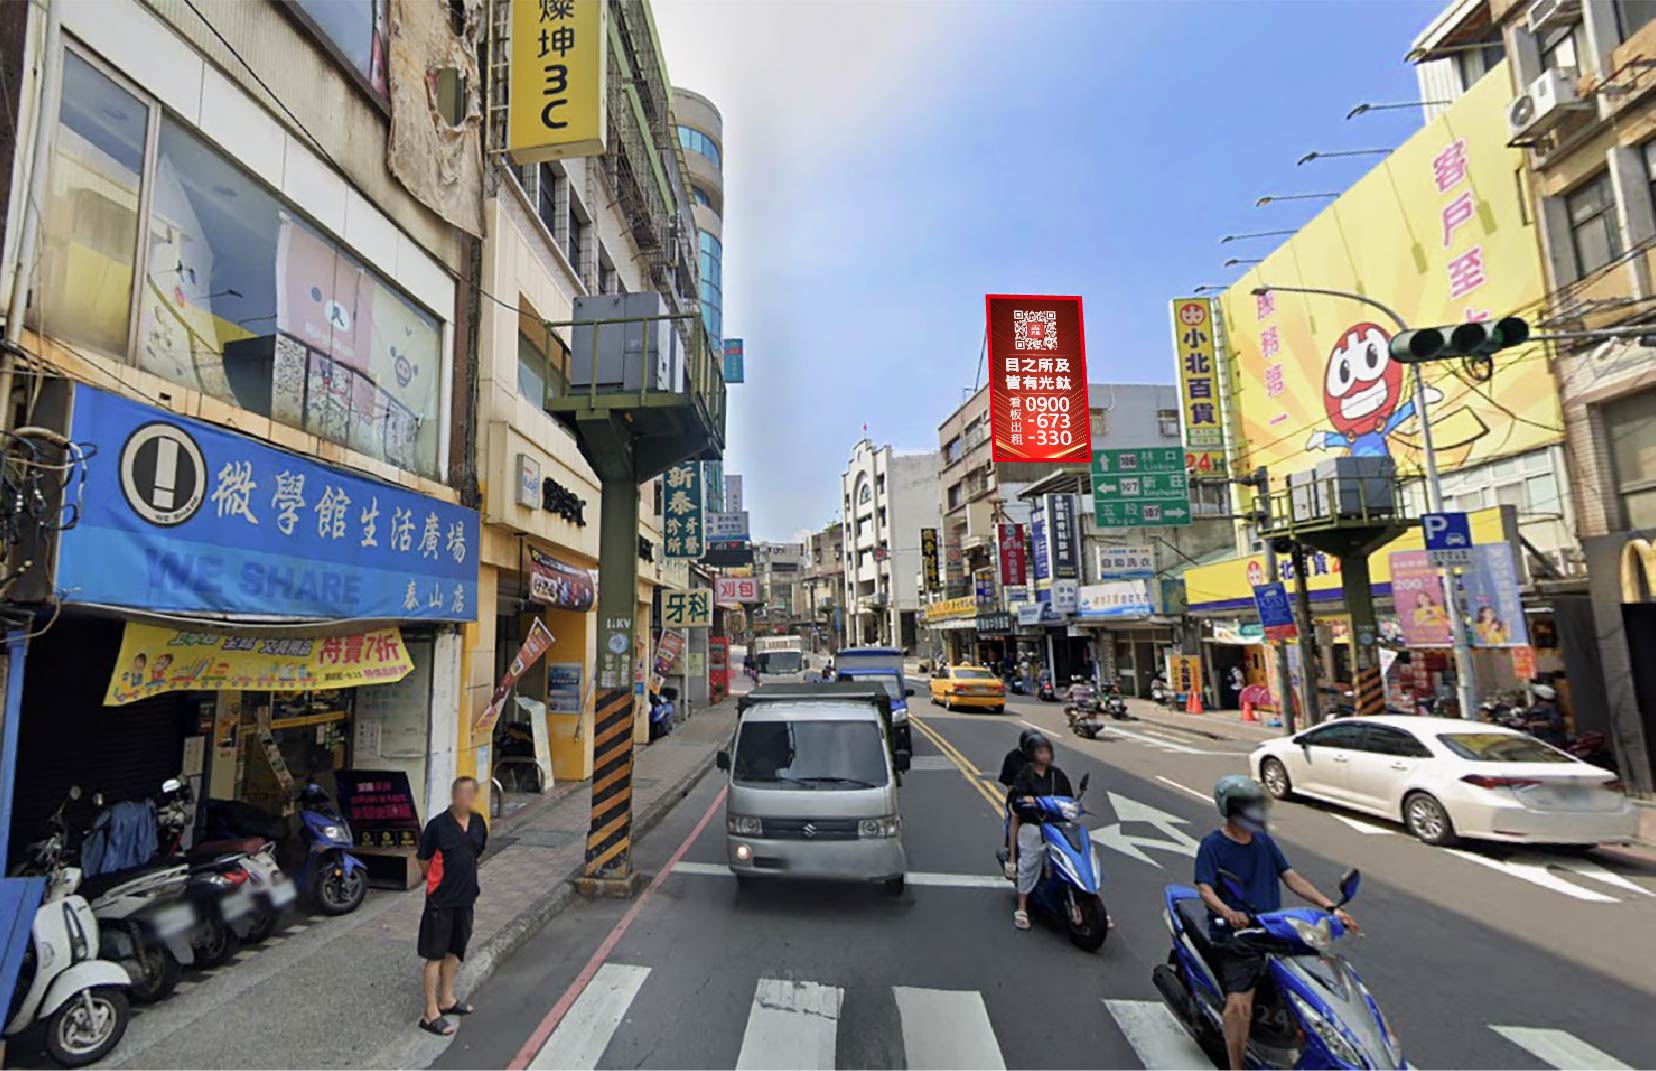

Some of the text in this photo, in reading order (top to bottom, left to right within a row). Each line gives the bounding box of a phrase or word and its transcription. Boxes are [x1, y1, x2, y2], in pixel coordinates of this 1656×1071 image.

[538, 0, 575, 129] 燦坤3C
[1005, 357, 1071, 373] 目之所及
[1183, 328, 1216, 424] 小北百貨
[1005, 375, 1072, 391] 皆有光鈦
[1025, 396, 1070, 412] 0900
[1009, 397, 1023, 446] 看板出租
[1027, 413, 1070, 429] -673
[1027, 430, 1072, 446] -330
[667, 461, 699, 516] 新泰
[211, 460, 466, 563] 微學館生活廣場
[1424, 516, 1448, 540] P
[685, 516, 700, 555] 牙醫
[144, 547, 363, 606] WE SHARE
[721, 581, 754, 598] 刈包
[403, 577, 465, 614] 泰山店
[666, 591, 709, 624] 牙科
[317, 632, 400, 665] 特賣7折
